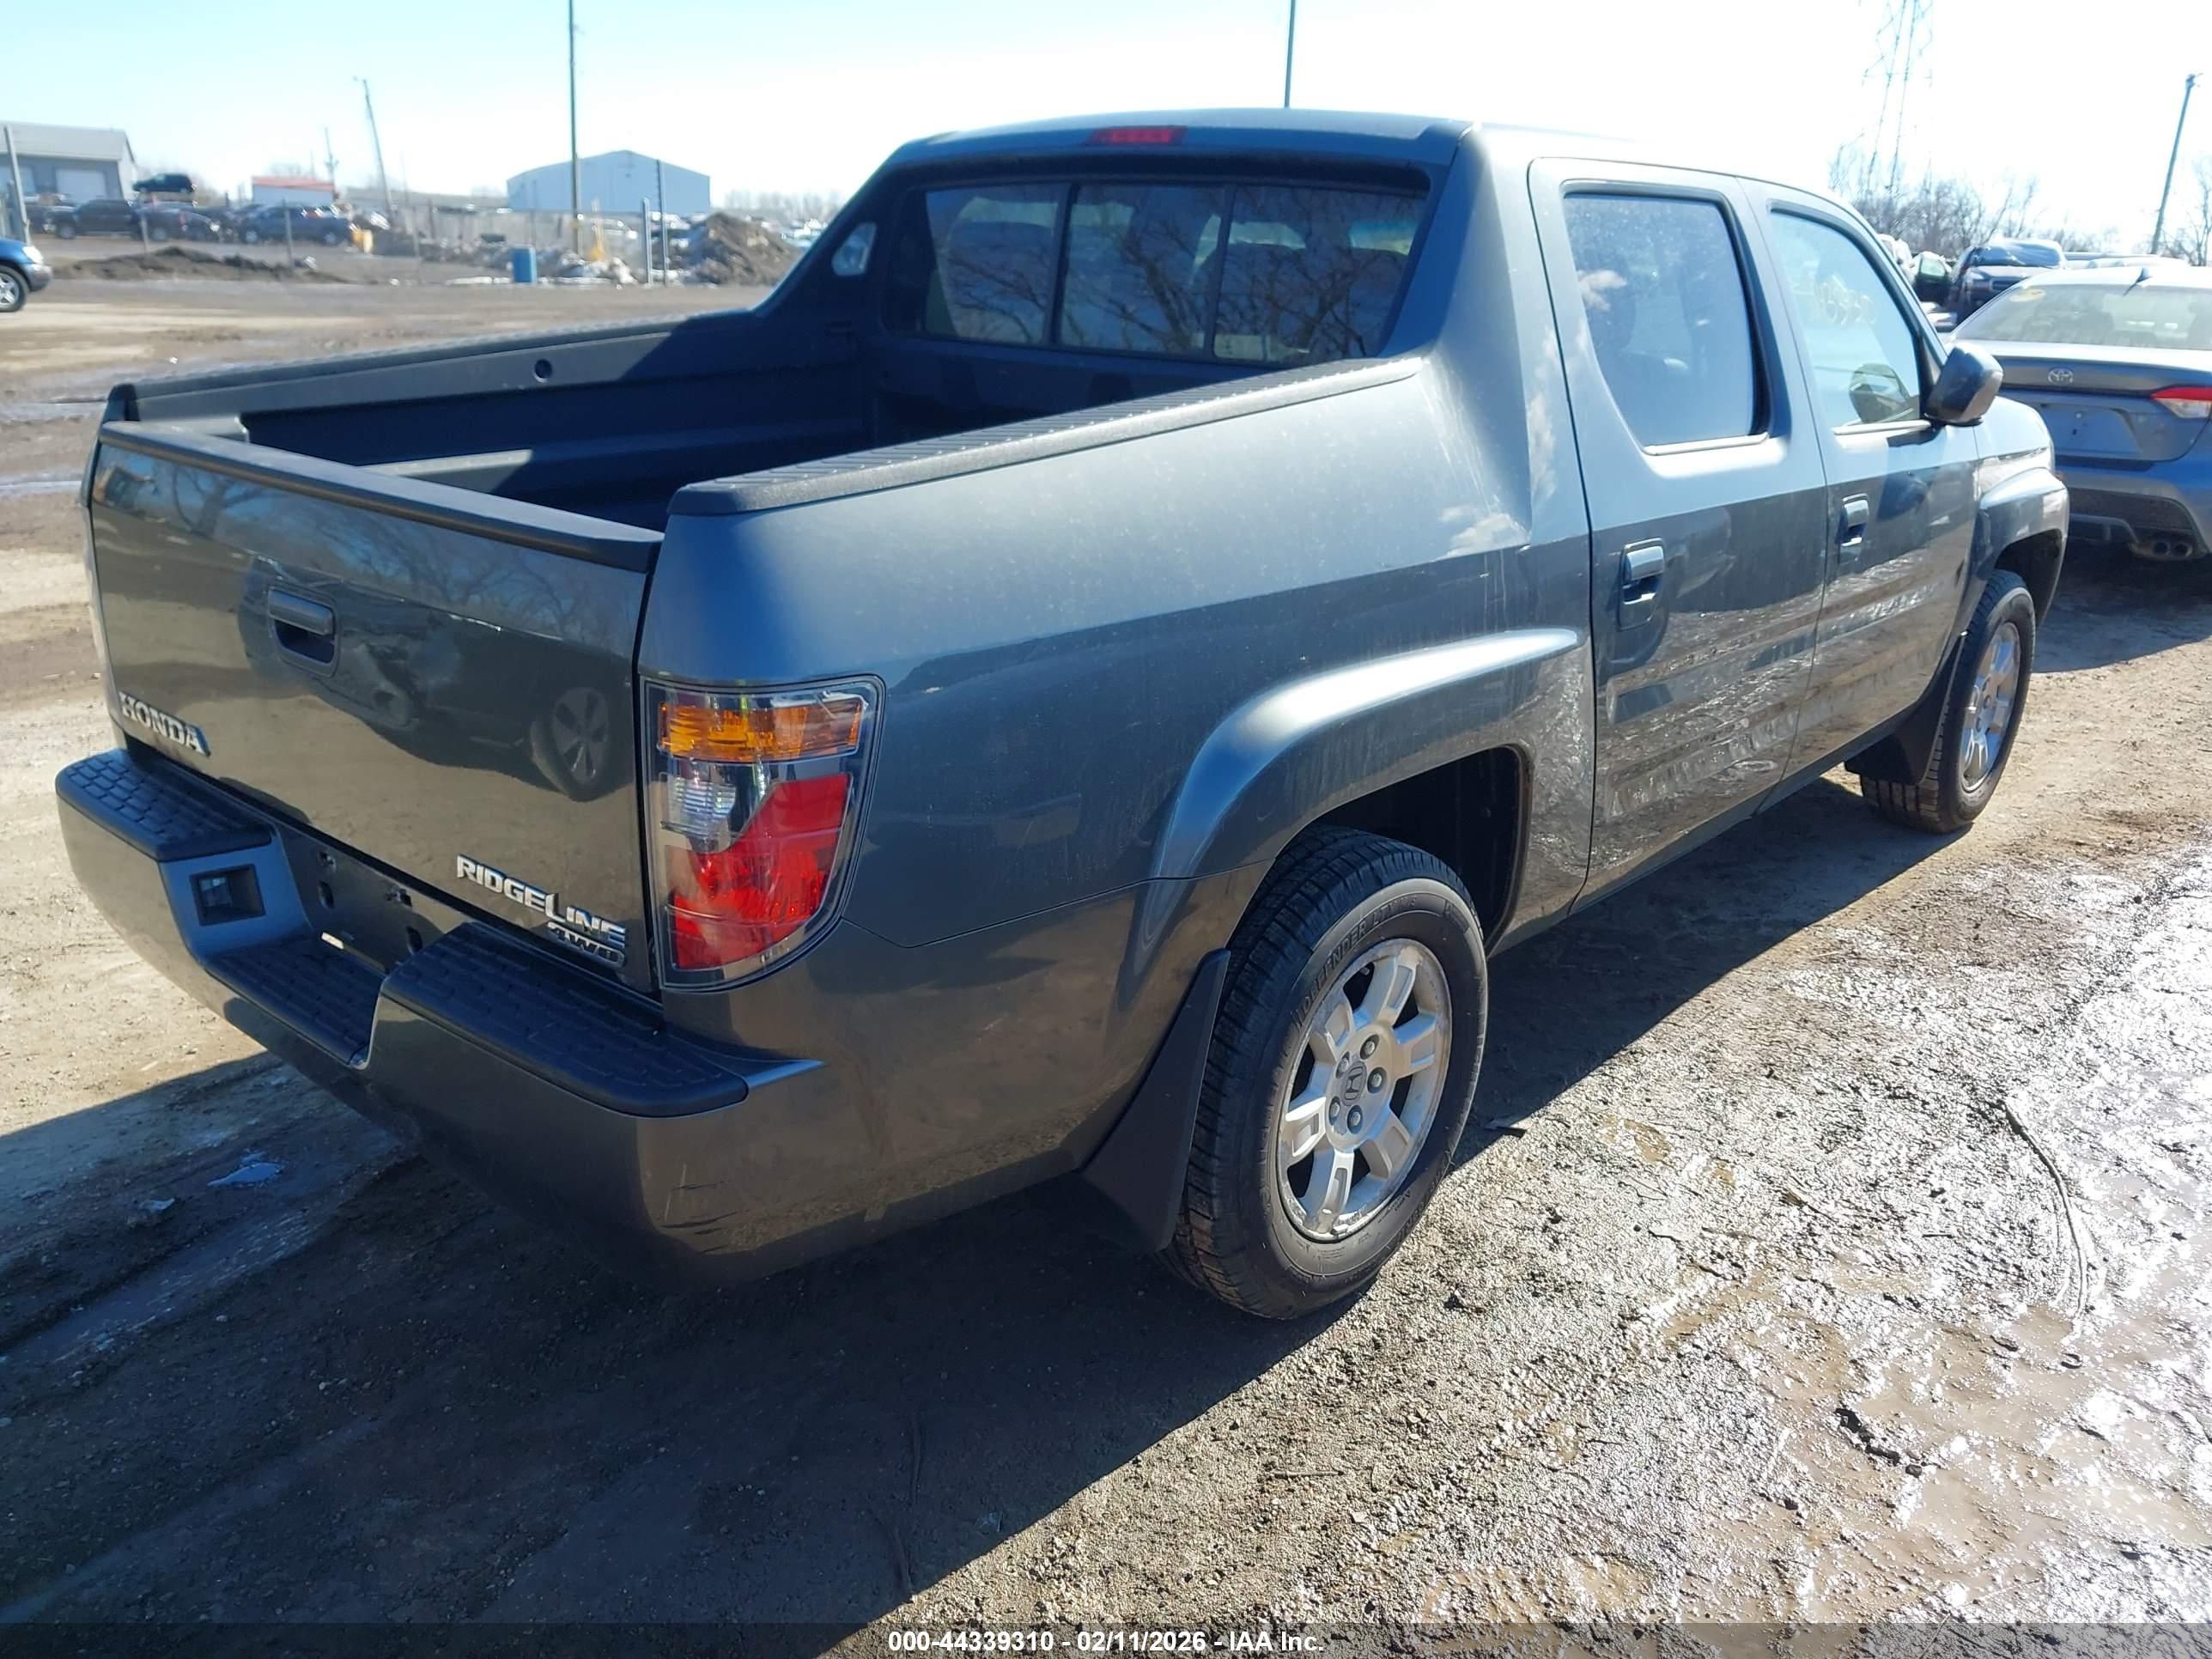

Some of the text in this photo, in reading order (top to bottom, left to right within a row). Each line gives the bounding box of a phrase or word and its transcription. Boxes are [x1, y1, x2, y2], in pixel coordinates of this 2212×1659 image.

[118, 691, 207, 756] HONDA
[457, 854, 626, 949] RIDGELINE
[547, 921, 625, 968] 4WD
